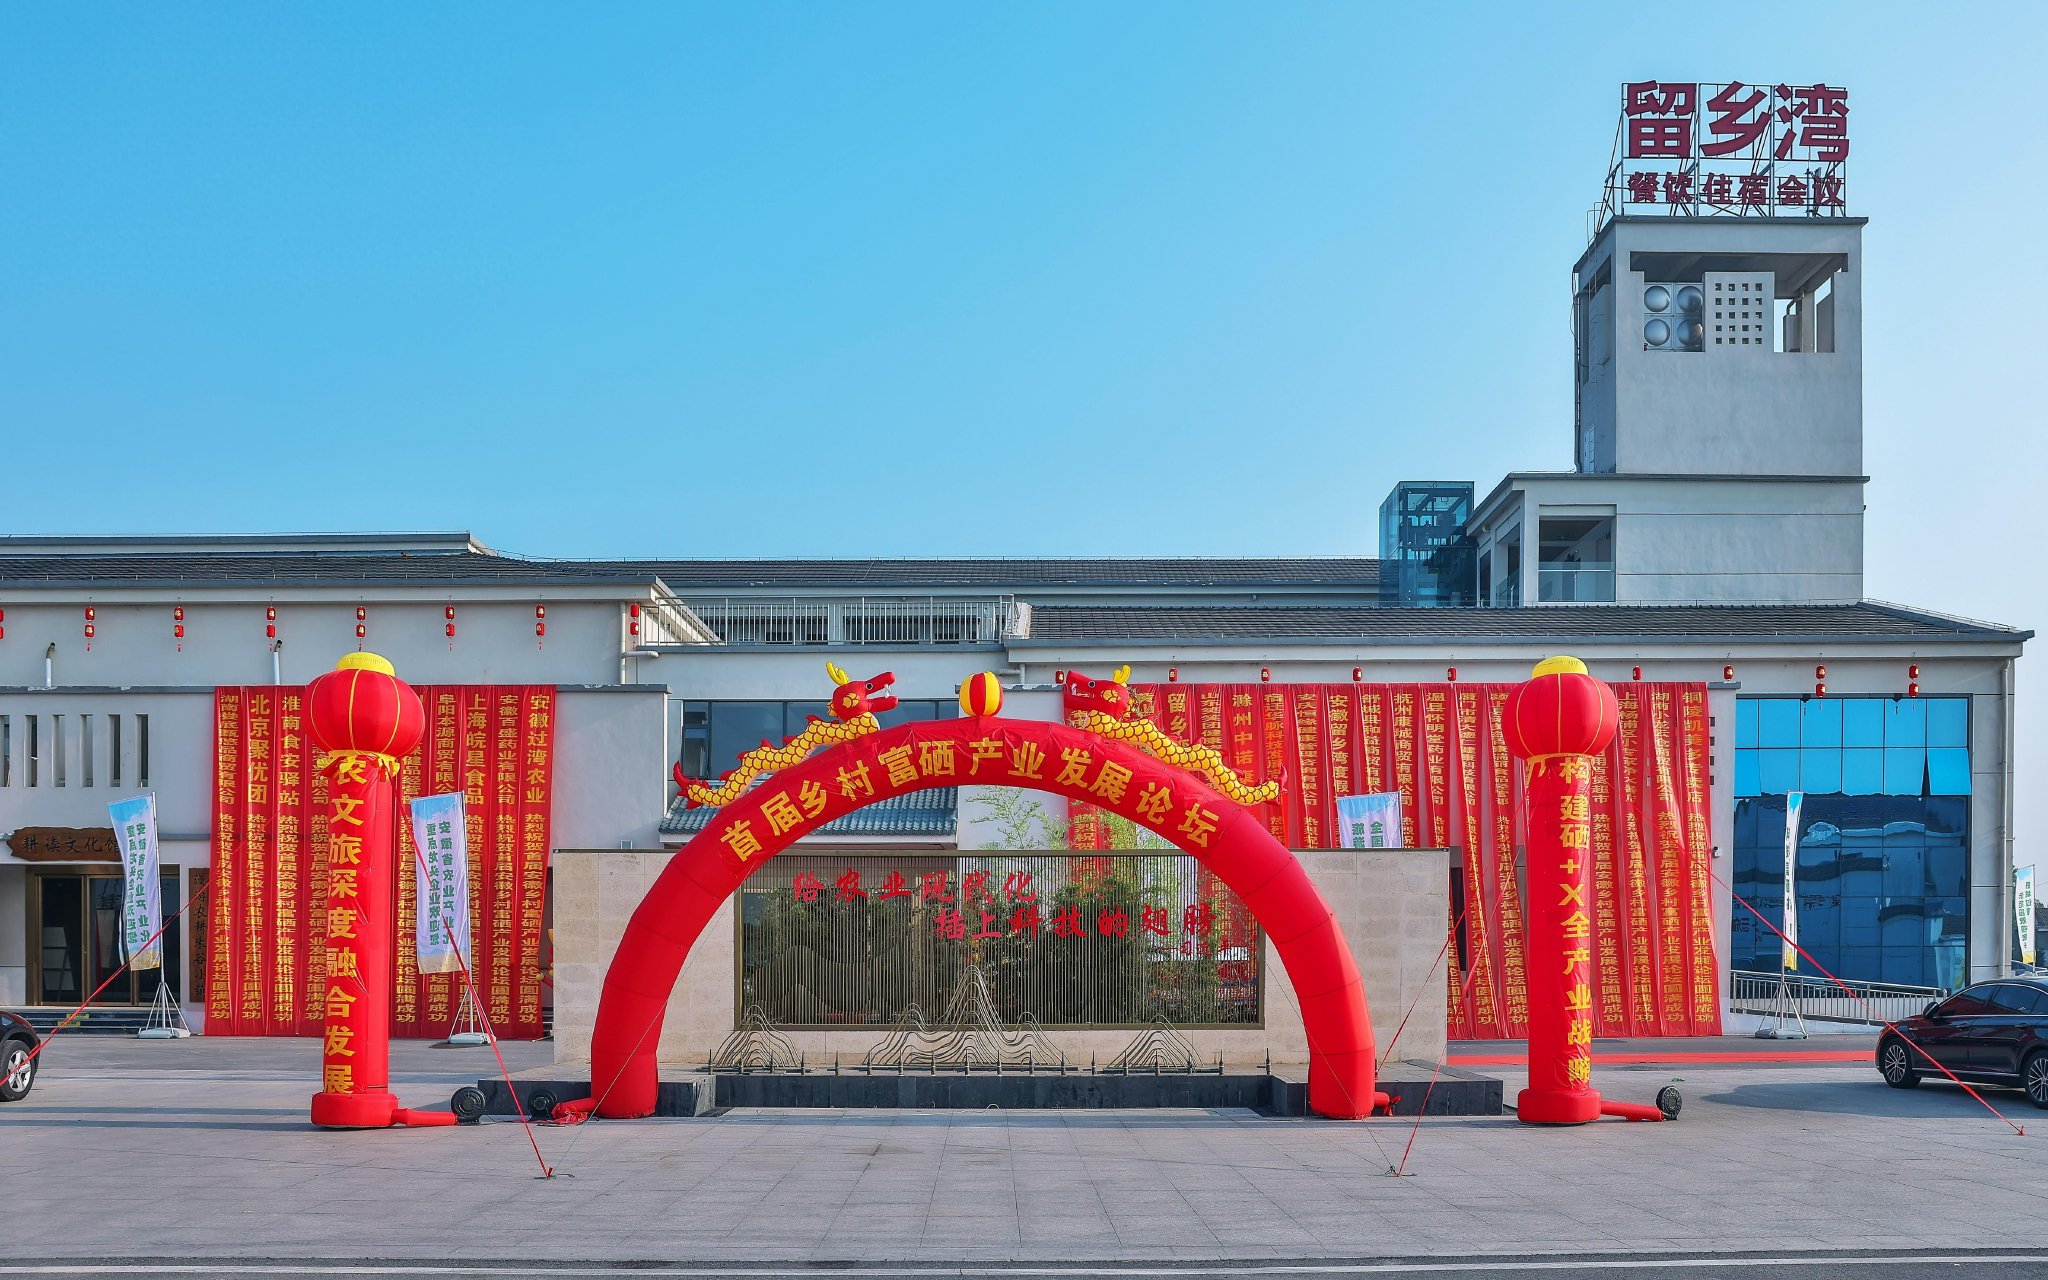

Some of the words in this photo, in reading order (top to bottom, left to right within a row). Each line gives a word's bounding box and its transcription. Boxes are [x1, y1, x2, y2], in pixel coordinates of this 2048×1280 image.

[1624, 79, 1850, 161] 留乡湾
[1627, 172, 1845, 206] 餐饮住宿会议
[247, 694, 270, 805] 北京聚优团
[277, 695, 301, 806] 淮南食安驿站
[465, 693, 487, 805] 上海皖星食品
[497, 695, 519, 805] 安徽百盛药业有限公司
[525, 694, 550, 804] 安徽过湾农业
[720, 736, 1221, 861] 首届乡村富硒产业发展论坛
[324, 757, 367, 1094] 农文旅深度融合发展
[489, 814, 516, 1024] 热烈祝贺首届安徽乡村富硒产业发展论坛圆满成功
[518, 813, 546, 1024] 热烈祝贺首届安徽乡村富硒产业发展论坛圆满成功
[793, 868, 1037, 904] 给农业现代化
[933, 903, 1217, 941] 插上科技的翅膀
[1592, 813, 1623, 1023] 热烈祝贺首届安徽乡村富硒产业发展论坛圆满成功
